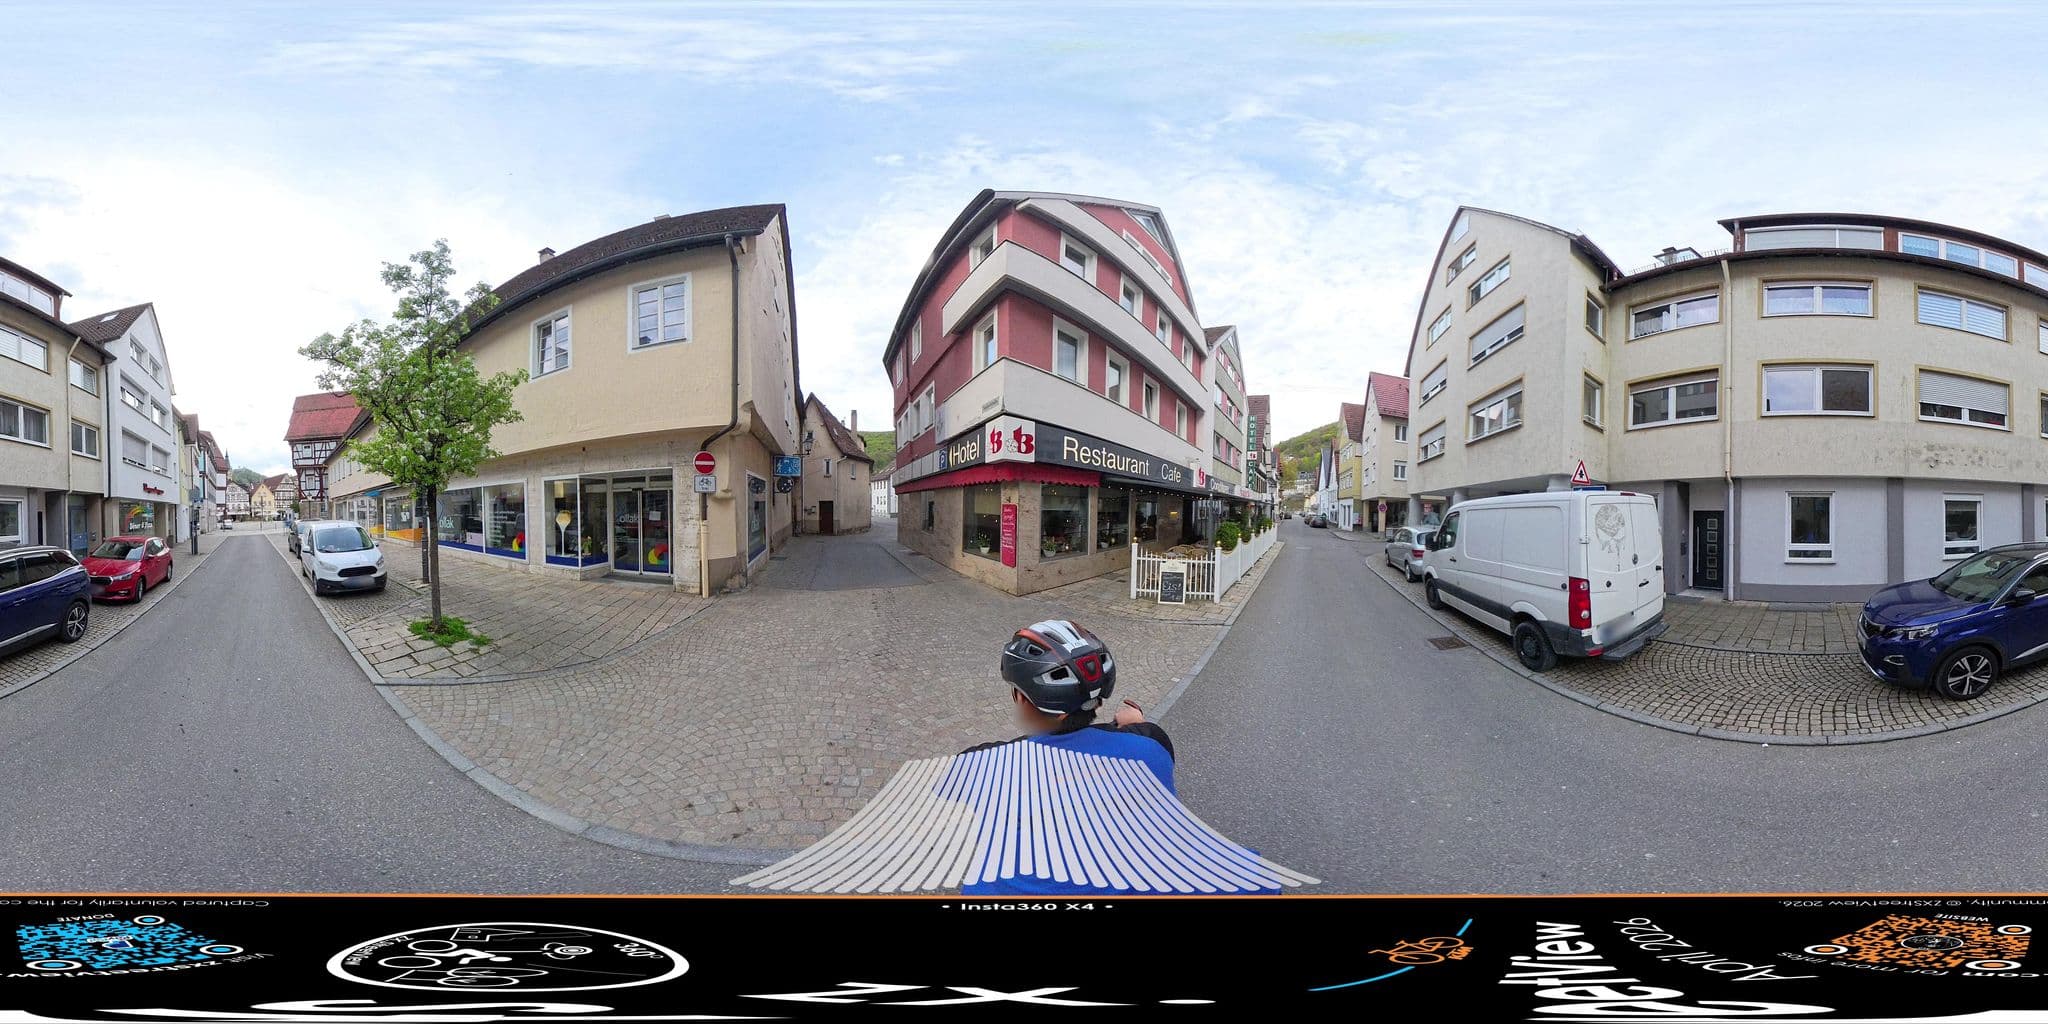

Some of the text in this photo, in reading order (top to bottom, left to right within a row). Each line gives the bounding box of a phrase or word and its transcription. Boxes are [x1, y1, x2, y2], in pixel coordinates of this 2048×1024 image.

[953, 434, 980, 466] Hotel
[1063, 435, 1182, 483] Restaurant Cafe
